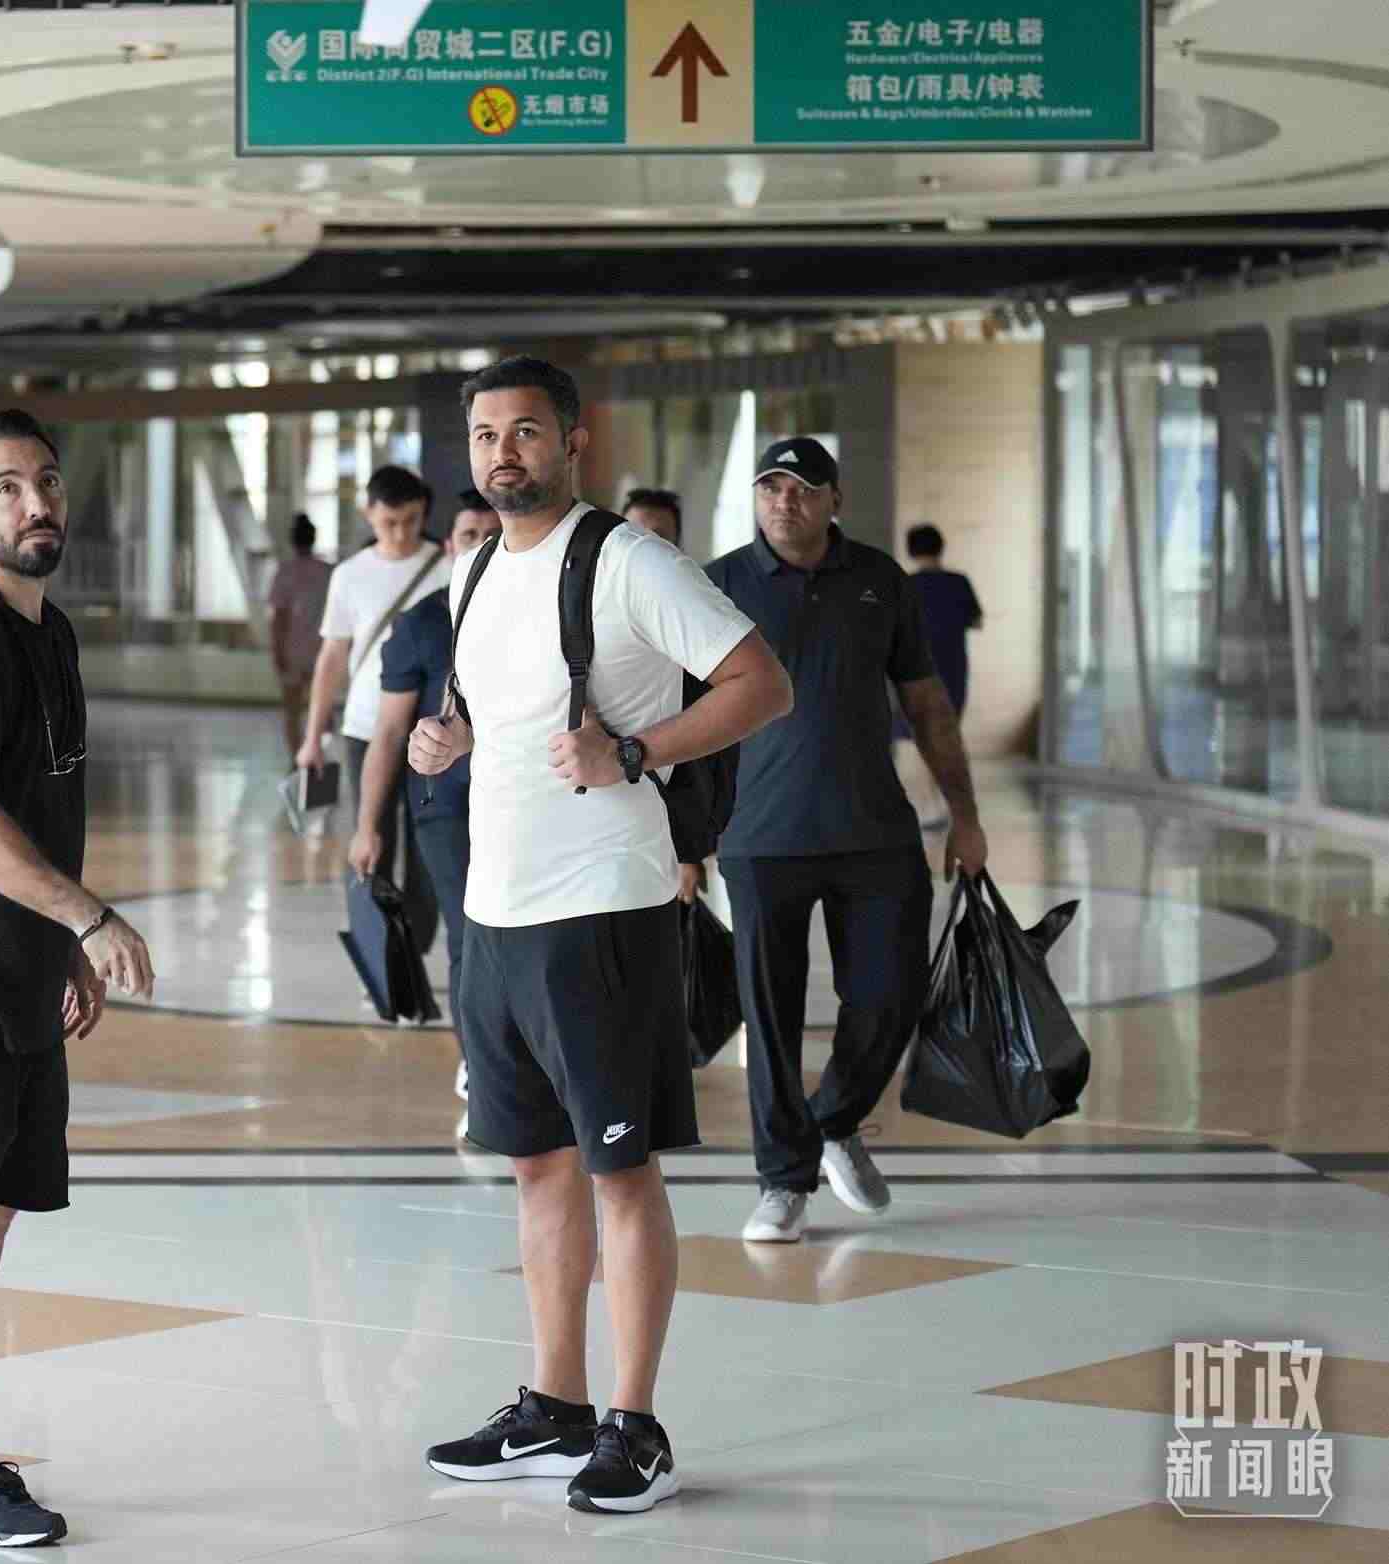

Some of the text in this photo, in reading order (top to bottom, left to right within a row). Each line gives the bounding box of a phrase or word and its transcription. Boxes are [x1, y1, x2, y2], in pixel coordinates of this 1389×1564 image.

[846, 18, 1044, 47] 五金/电子/电器
[317, 68, 372, 81] District
[427, 67, 527, 81] International
[531, 67, 574, 81] Trade
[577, 66, 608, 82] City
[846, 72, 1044, 101] 箱包/雨具/钟表
[523, 94, 609, 115] 无烟市场
[606, 1122, 627, 1137] NIKE
